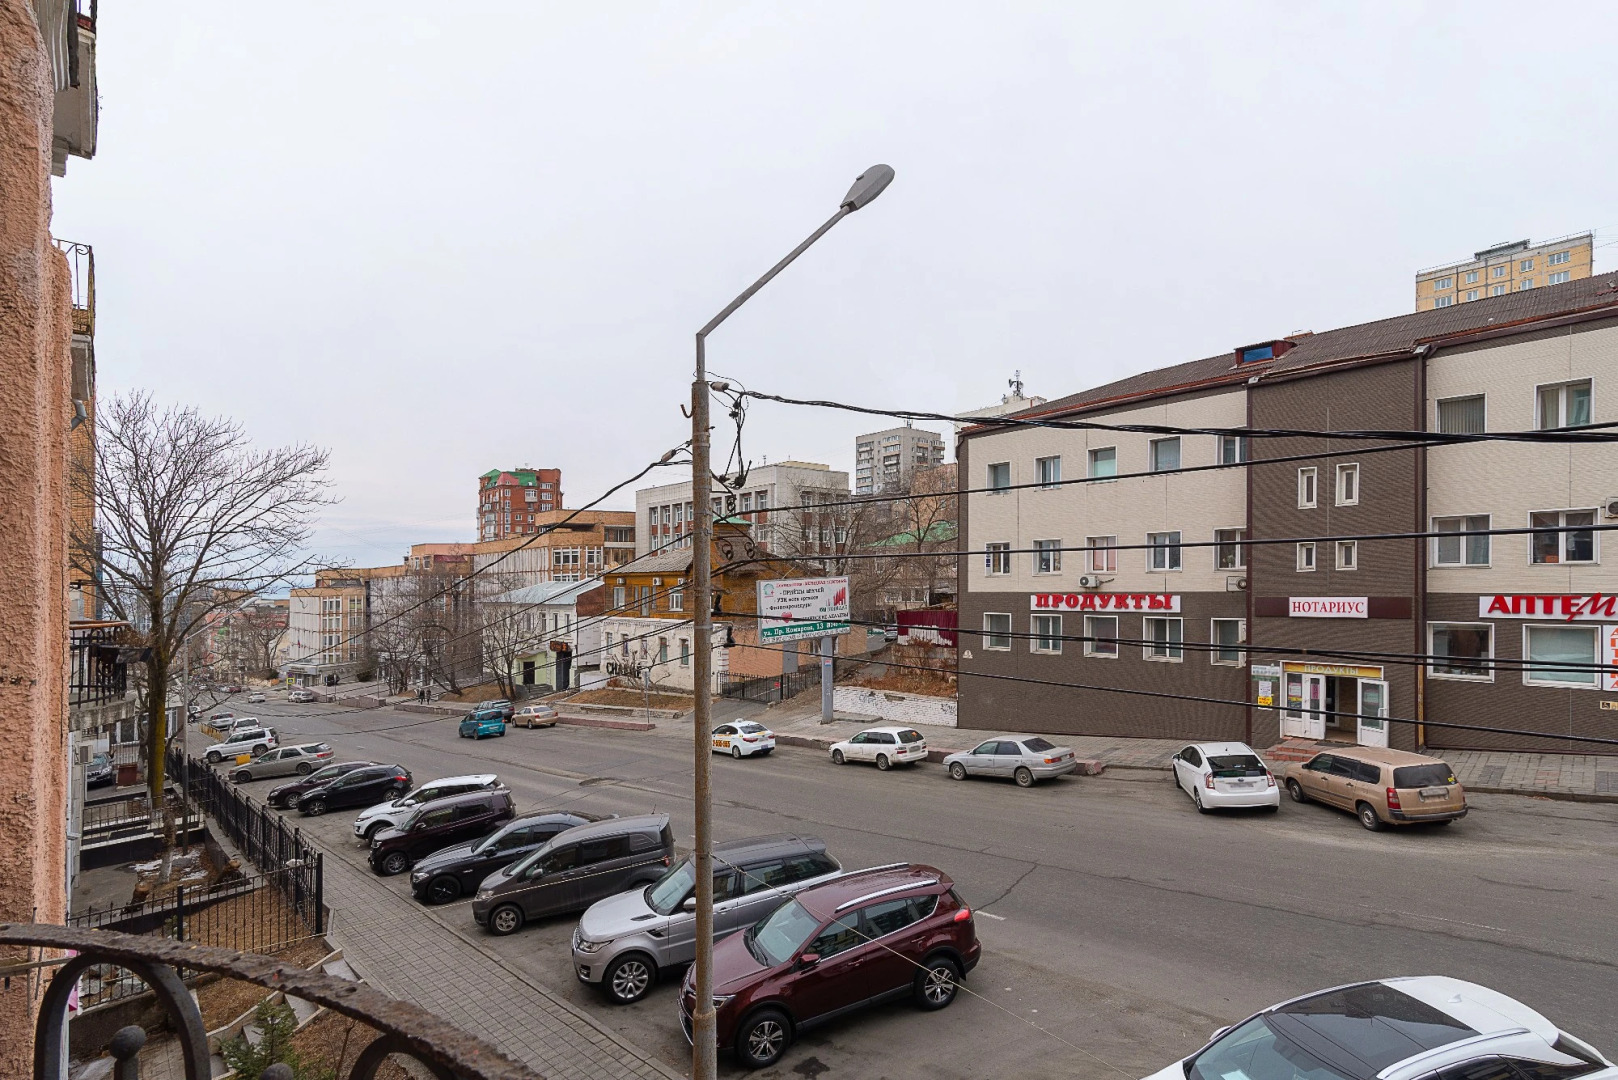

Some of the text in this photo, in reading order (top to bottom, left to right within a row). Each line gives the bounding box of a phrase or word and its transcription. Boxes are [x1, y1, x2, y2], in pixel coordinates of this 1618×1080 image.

[1035, 594, 1173, 610] ПРОДУКТЫ
[1292, 601, 1364, 614] НОТАРИУС
[816, 622, 824, 630] 13
[1304, 664, 1359, 675] ПРОДУКТЫ
